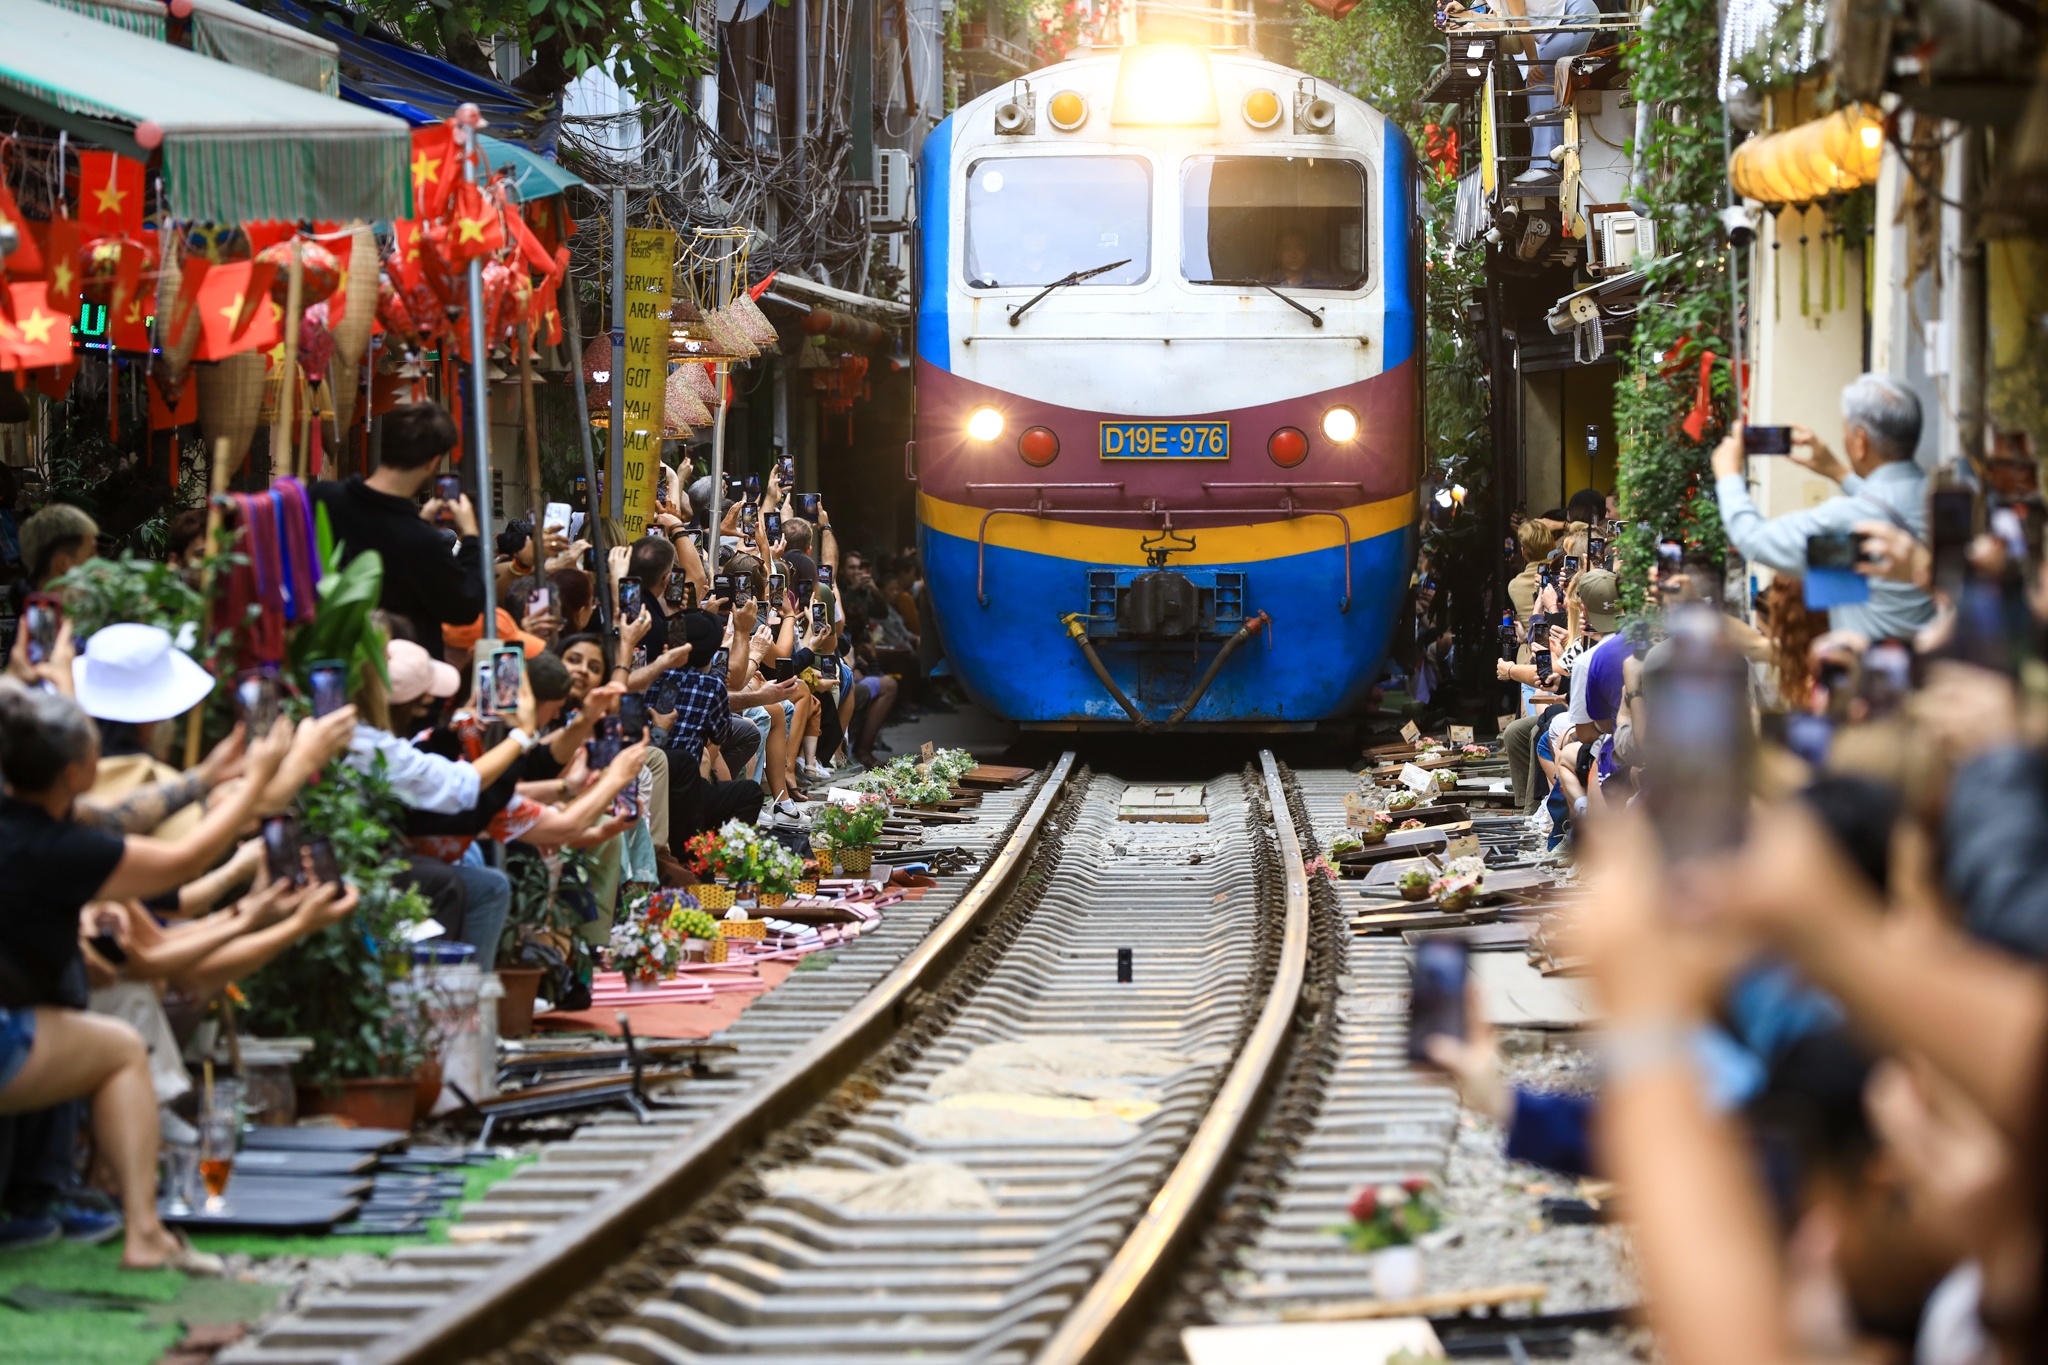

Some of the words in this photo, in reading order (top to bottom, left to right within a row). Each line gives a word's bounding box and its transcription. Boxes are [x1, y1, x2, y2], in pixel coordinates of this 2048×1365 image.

[625, 274, 665, 293] SERVICE
[628, 301, 657, 319] AREA
[629, 335, 651, 354] WE
[626, 367, 651, 388] GOT
[625, 400, 651, 420] YAH
[1105, 427, 1223, 453] D19E-976
[625, 461, 645, 481] ND
